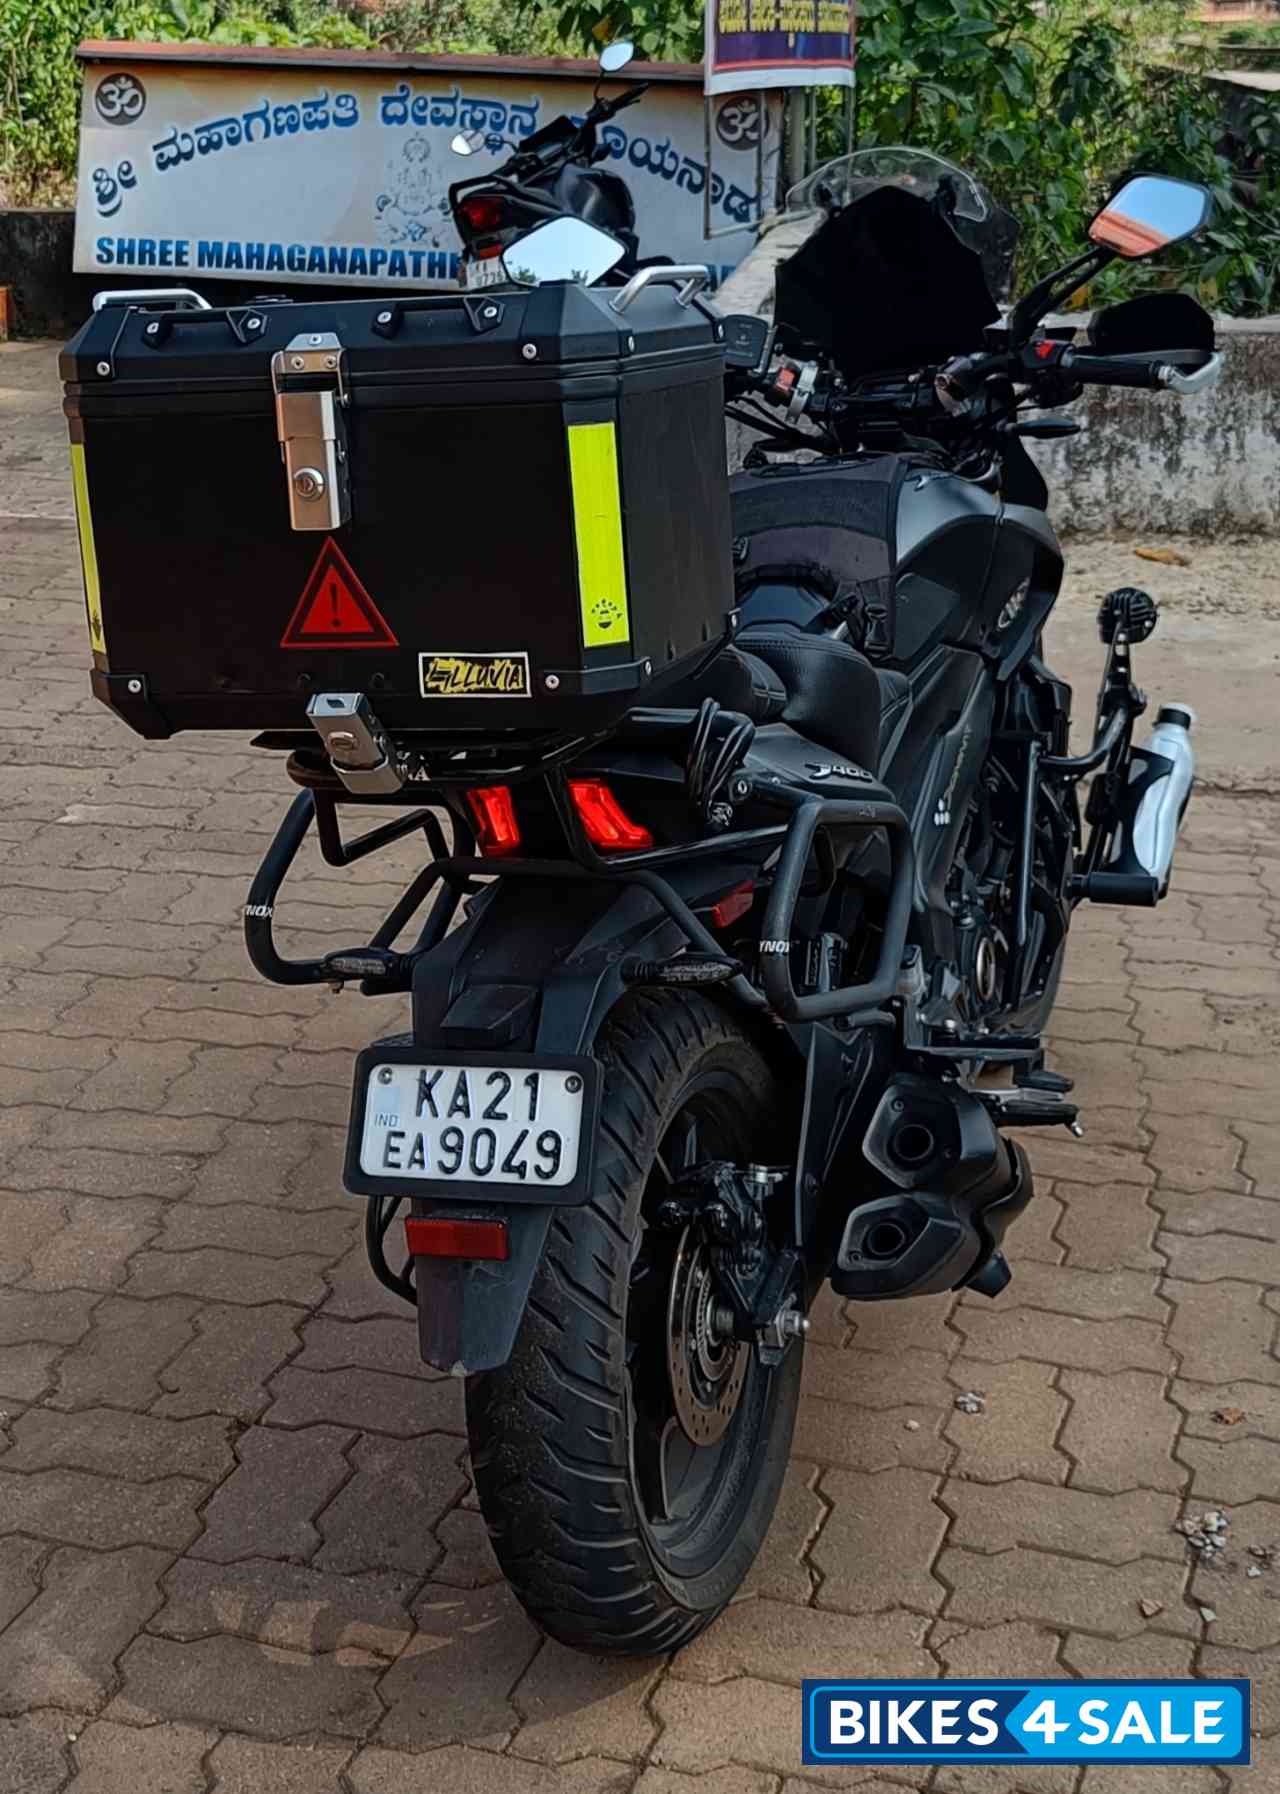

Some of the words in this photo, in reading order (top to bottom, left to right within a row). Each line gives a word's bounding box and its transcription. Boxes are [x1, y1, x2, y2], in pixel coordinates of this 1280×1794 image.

[92, 160, 137, 217] ಶ್ರೀ
[152, 89, 359, 171] ಮಹಾಗಣಪತಿ
[96, 236, 189, 268] SHREE
[374, 1112, 399, 1127] IND
[416, 1069, 539, 1121] KA21
[382, 1126, 562, 1180] EA9049
